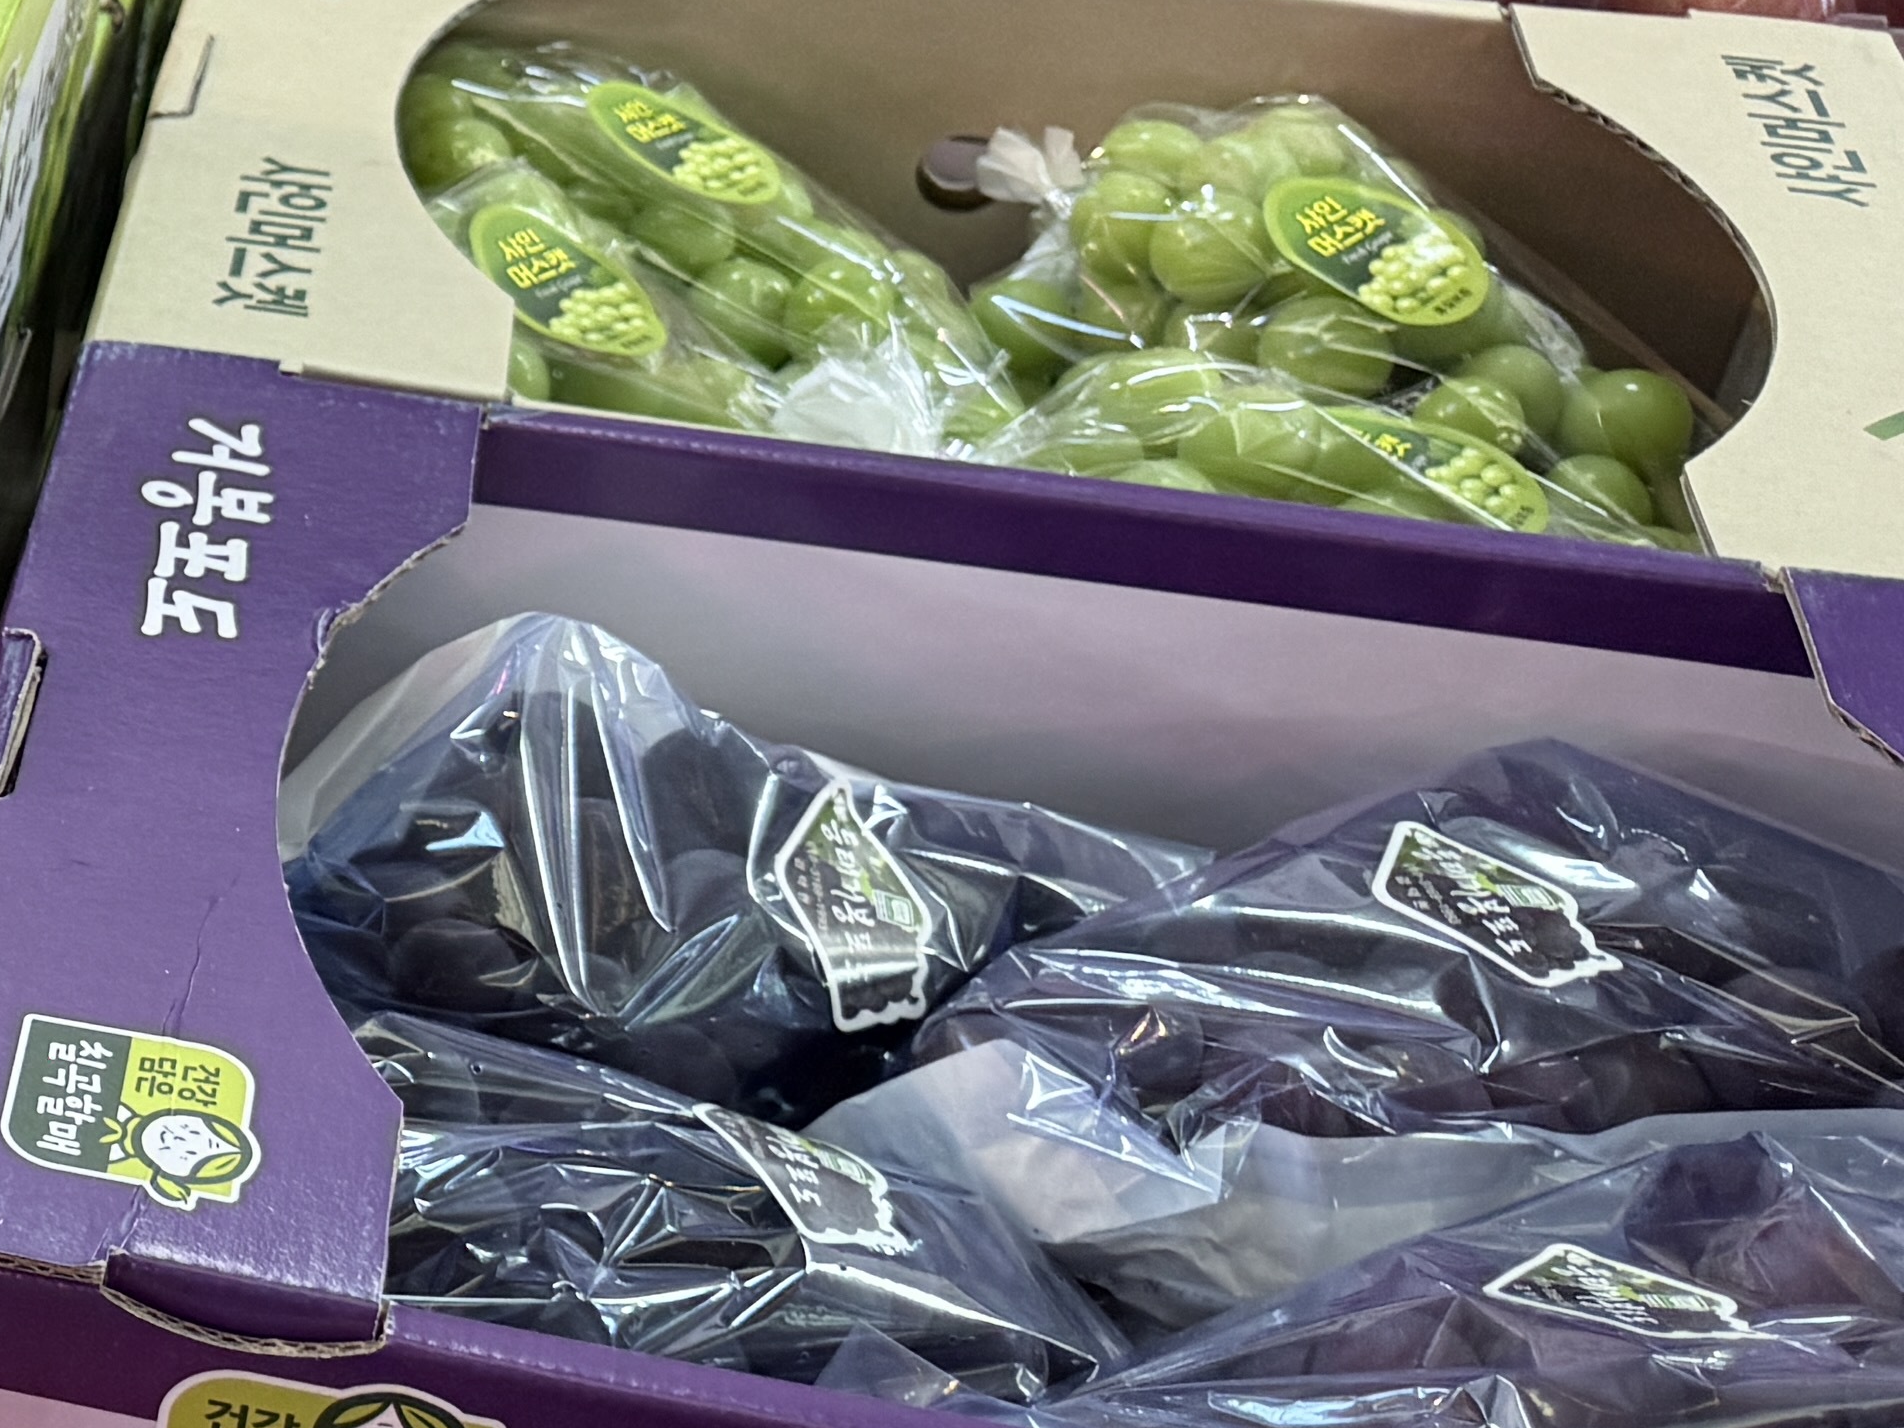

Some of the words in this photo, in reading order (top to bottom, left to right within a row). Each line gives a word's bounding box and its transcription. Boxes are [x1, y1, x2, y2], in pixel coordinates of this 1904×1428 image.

[1721, 55, 1877, 207] 샤인머스켓
[211, 155, 332, 319] 샤인머스켓
[1298, 197, 1342, 235] 샤인
[1312, 211, 1384, 258] 머스캣
[501, 235, 553, 263] 샤인
[140, 416, 276, 641] 거봉포도
[36, 1038, 113, 1154] 칠곡할매
[134, 1057, 177, 1097] 담은
[181, 1064, 221, 1107] 건강
